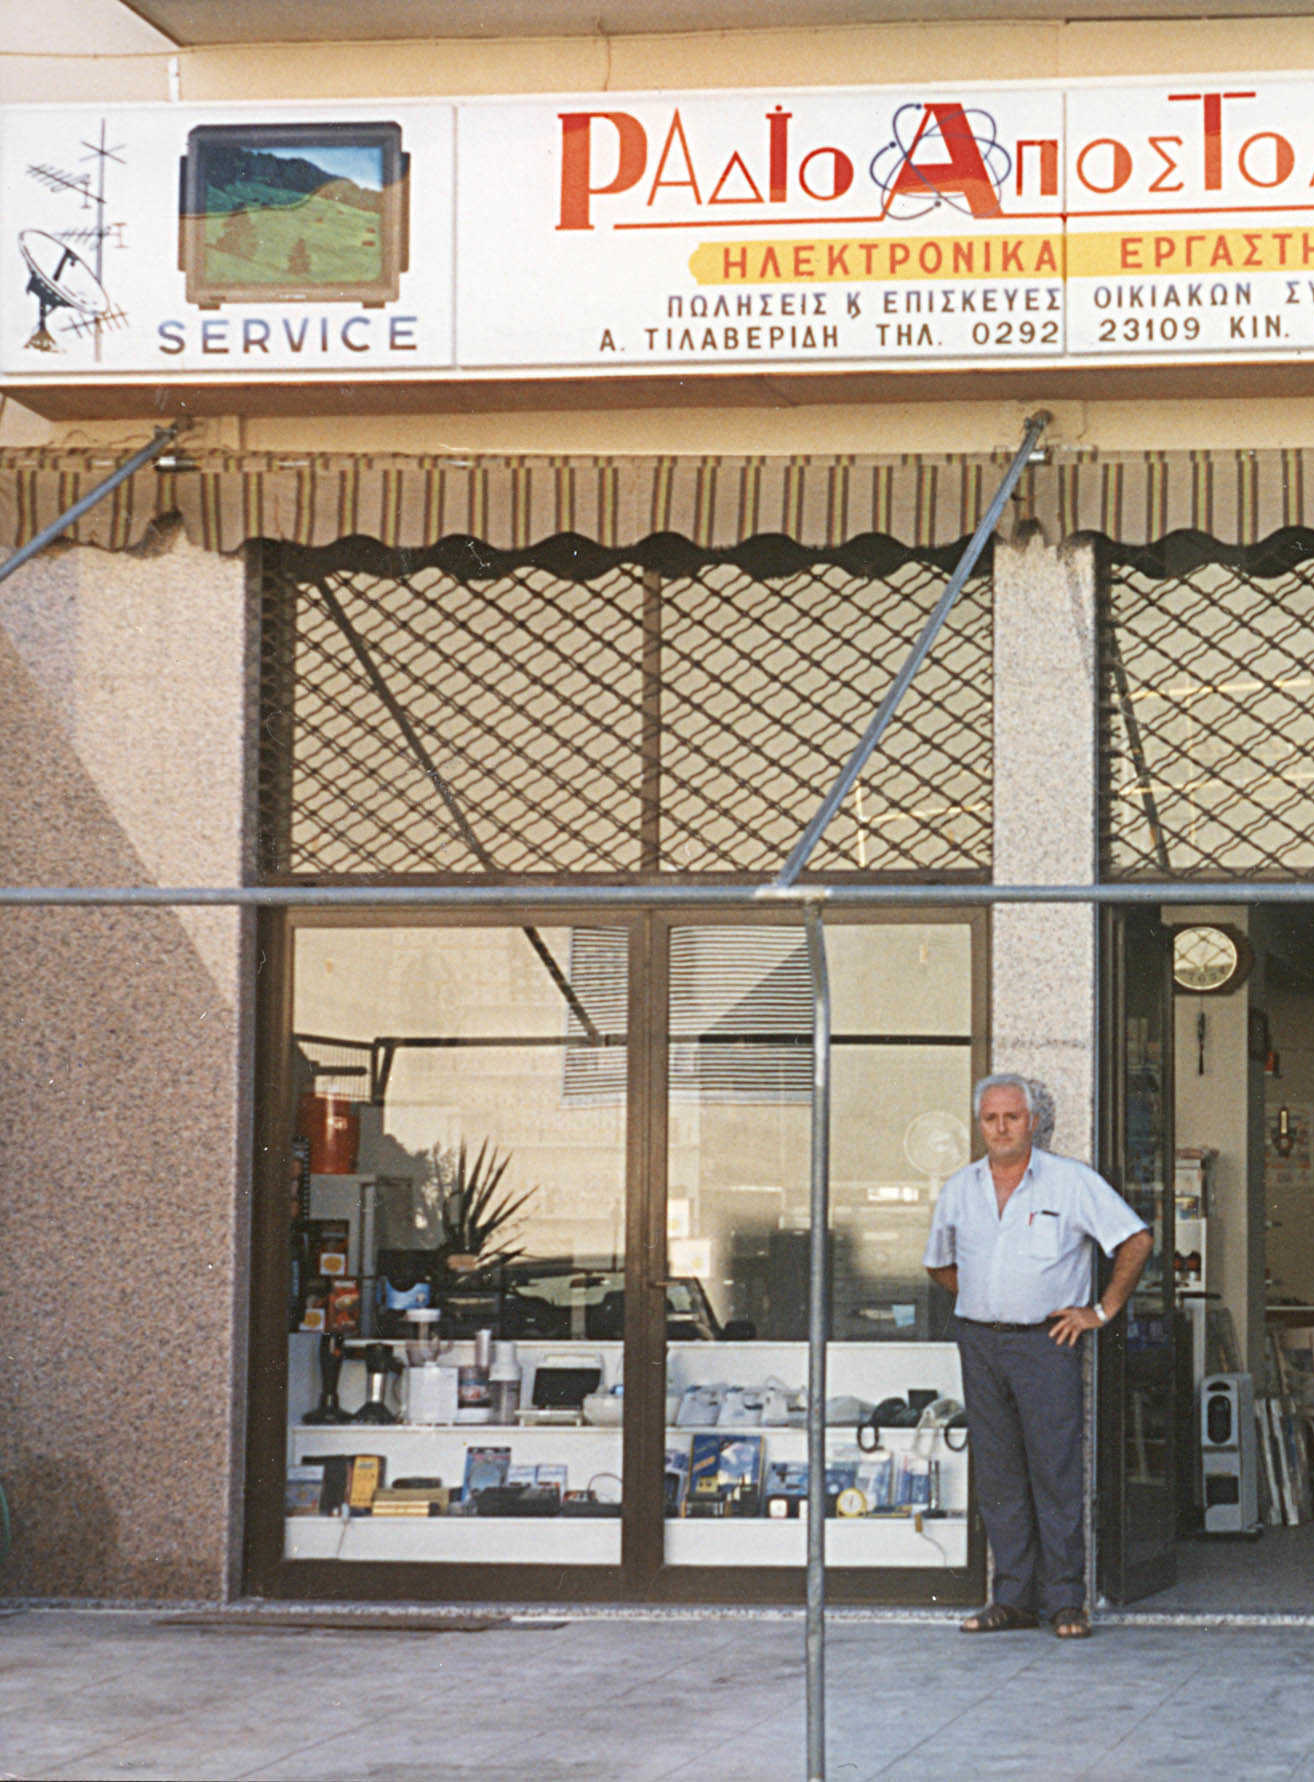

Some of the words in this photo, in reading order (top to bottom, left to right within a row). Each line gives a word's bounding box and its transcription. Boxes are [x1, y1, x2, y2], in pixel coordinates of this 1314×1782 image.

[723, 240, 1058, 280] ΗΛΕΚΤΡΟΝΙΚΑ
[668, 293, 828, 319] ΠΩΛΗΣΕΙΣ
[883, 288, 1062, 315] ΕΠΙΣΚΕΥΕΣ
[1094, 283, 1253, 310] ΟΙΚΙΑΚΩΝ
[158, 316, 419, 357] SERVICE
[645, 325, 840, 352] ΤΙΛΑΒΕΡΙΔΗ
[876, 323, 943, 348] ΤΗΛ.
[972, 320, 1060, 347] 0292
[1099, 317, 1202, 344] 23109
[1230, 315, 1290, 340] ΚΙΝ.
